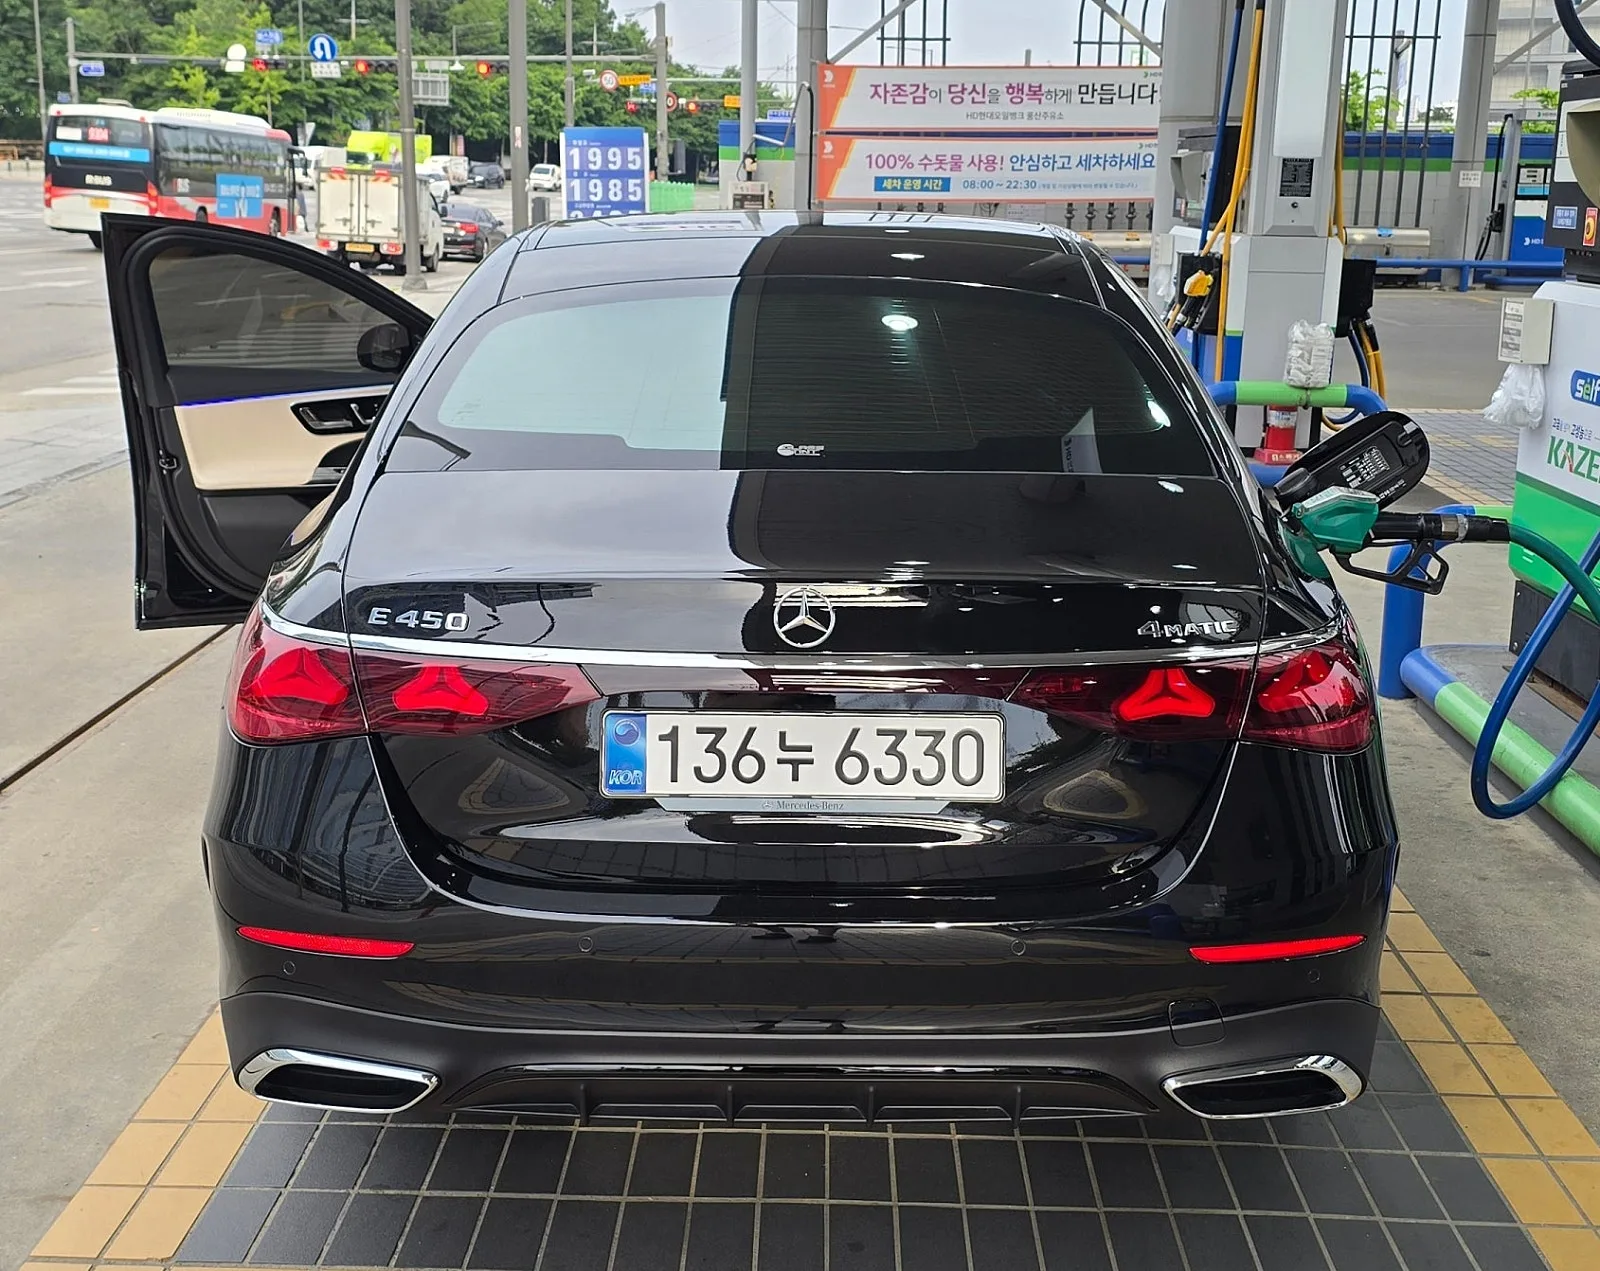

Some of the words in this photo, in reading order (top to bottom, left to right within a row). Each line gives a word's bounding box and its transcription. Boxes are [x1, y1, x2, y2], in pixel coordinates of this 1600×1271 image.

[870, 82, 942, 105] 자존감이
[948, 82, 1001, 105] 당신을
[1005, 82, 1072, 105] 행복하게
[569, 147, 641, 170] 1995
[865, 153, 914, 170] 100%
[918, 154, 964, 172] 수돗물
[967, 154, 1004, 172] 사용!
[1009, 153, 1072, 172] 안심하고
[1076, 152, 1156, 171] 세차하세요
[570, 178, 642, 202] 1985
[882, 178, 901, 189] 세차
[903, 179, 921, 190] 운영
[923, 179, 942, 190] 시간
[963, 180, 994, 189] 08:00
[1006, 180, 1037, 190] 22:30
[1547, 435, 1600, 484] KAZE
[367, 607, 392, 626] E
[394, 609, 470, 632] 450
[1137, 619, 1239, 638] 4MATIC
[658, 725, 815, 784] 136누
[834, 727, 985, 787] 6330
[608, 769, 642, 785] KOR
[776, 800, 844, 811] Mercedes-Benz
